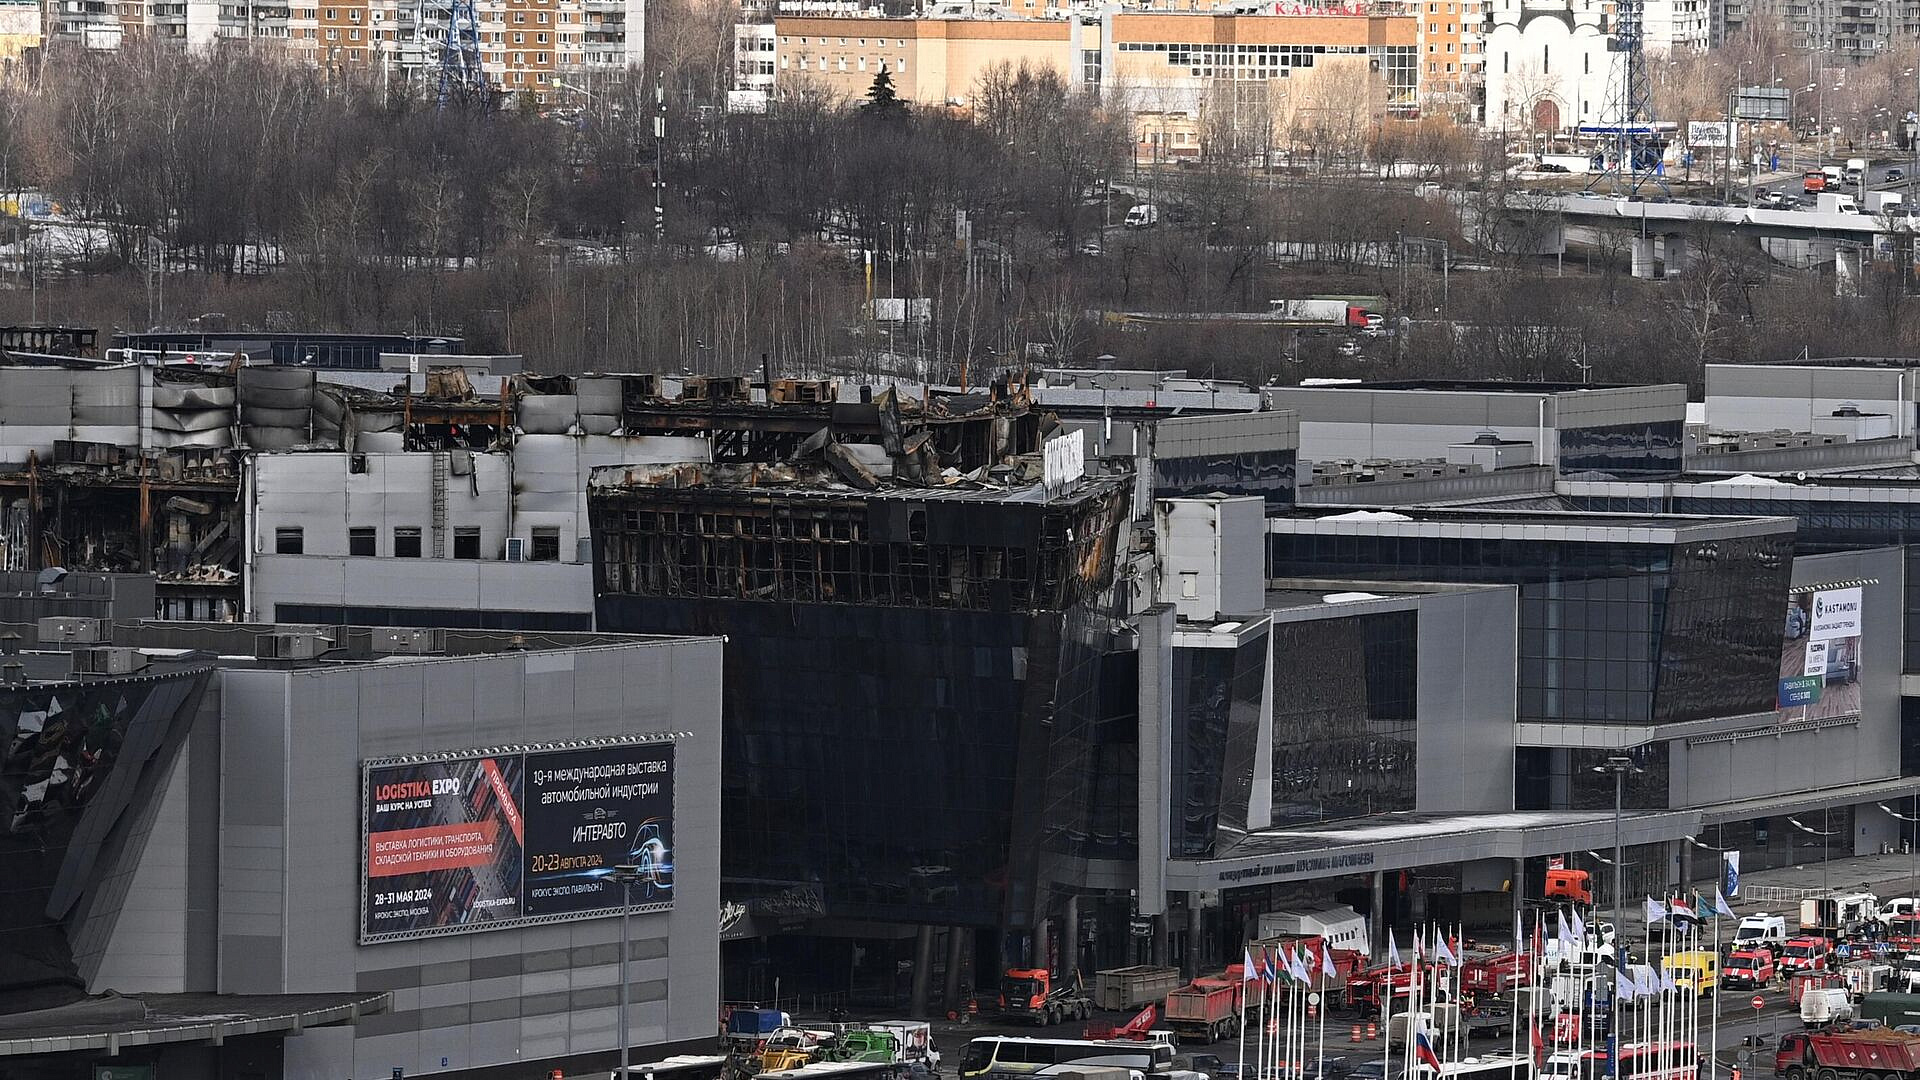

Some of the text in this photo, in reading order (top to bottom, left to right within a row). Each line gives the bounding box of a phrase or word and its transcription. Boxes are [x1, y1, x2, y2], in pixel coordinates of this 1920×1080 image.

[1275, 3, 1364, 16] КАРАОКЕ
[1825, 602, 1857, 614] KASTAMONU
[533, 760, 667, 786] 19-я международная выставка
[376, 777, 460, 800] LOGISTIKA EXPO
[490, 769, 518, 827] ПРЕМЬЕРА
[541, 781, 659, 804] автомобильной индустрии
[376, 800, 432, 813] ВАШ КУРС НА УСПЕХ
[572, 822, 627, 843] ИНТЕРАВТО
[375, 839, 408, 852] ВЫСТАВКА
[375, 844, 493, 866] СКЛАДСКОЙ ТЕХНИКИ И ОБОРУДОВАНИЯ
[532, 854, 603, 873] 20-23 АВГУСТА 2024
[396, 890, 414, 903] МАЯ
[414, 888, 433, 901] 2024
[532, 888, 552, 898] КРОКУС
[571, 883, 599, 895] ПАВИЛЬОН
